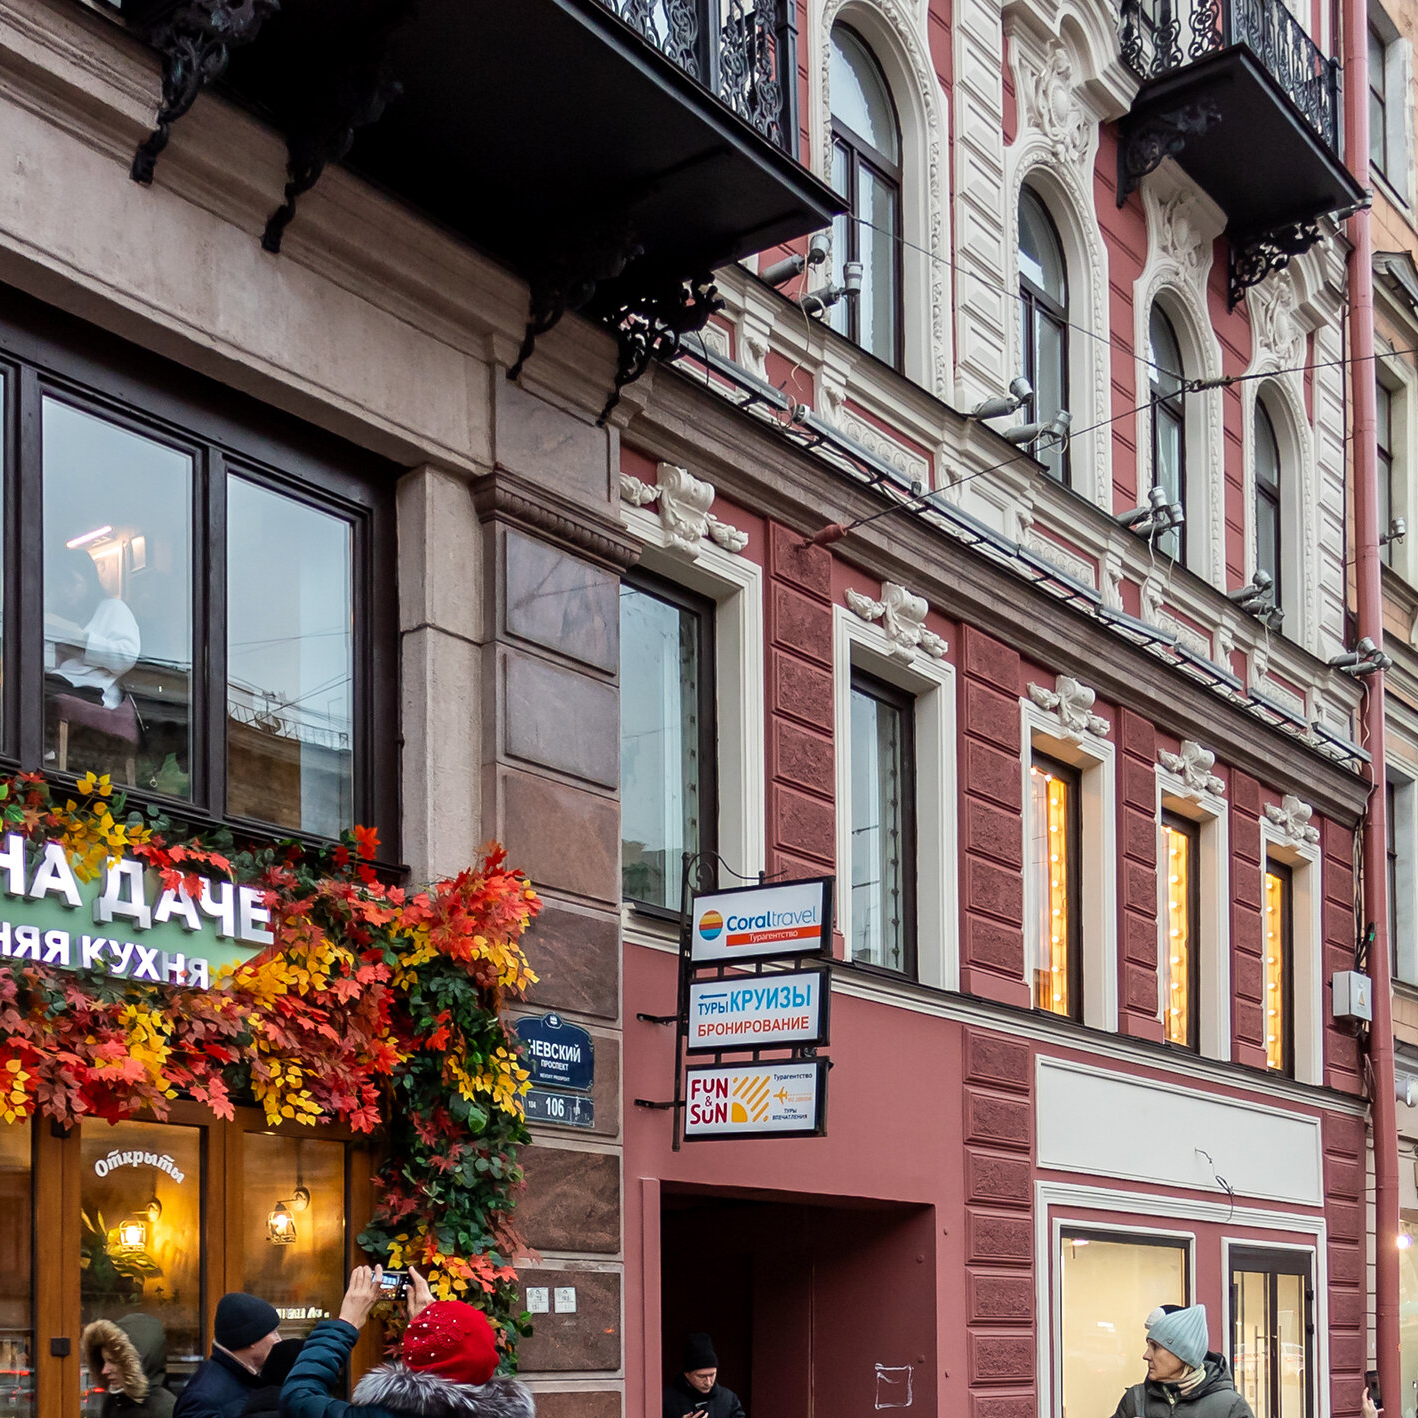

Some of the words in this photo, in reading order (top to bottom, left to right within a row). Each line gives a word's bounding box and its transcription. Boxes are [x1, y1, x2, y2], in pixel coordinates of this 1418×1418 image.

[95, 856, 274, 945] ДАЧЕ
[748, 930, 798, 942] Турагентство
[80, 934, 210, 991] КУХНЯ
[698, 1001, 729, 1015] ТУРЫ
[730, 984, 811, 1012] КРУИЗЫ
[698, 1016, 809, 1037] БРОНИРОВАНИЕ
[528, 1039, 581, 1063] НЕВСКИЙ
[541, 1059, 569, 1071] ПРОСПЕКТ
[773, 1073, 813, 1081] Турагентство
[691, 1077, 728, 1100] FUN
[545, 1097, 565, 1117] 106
[704, 1095, 713, 1107] &
[94, 1149, 185, 1184] Открыты
